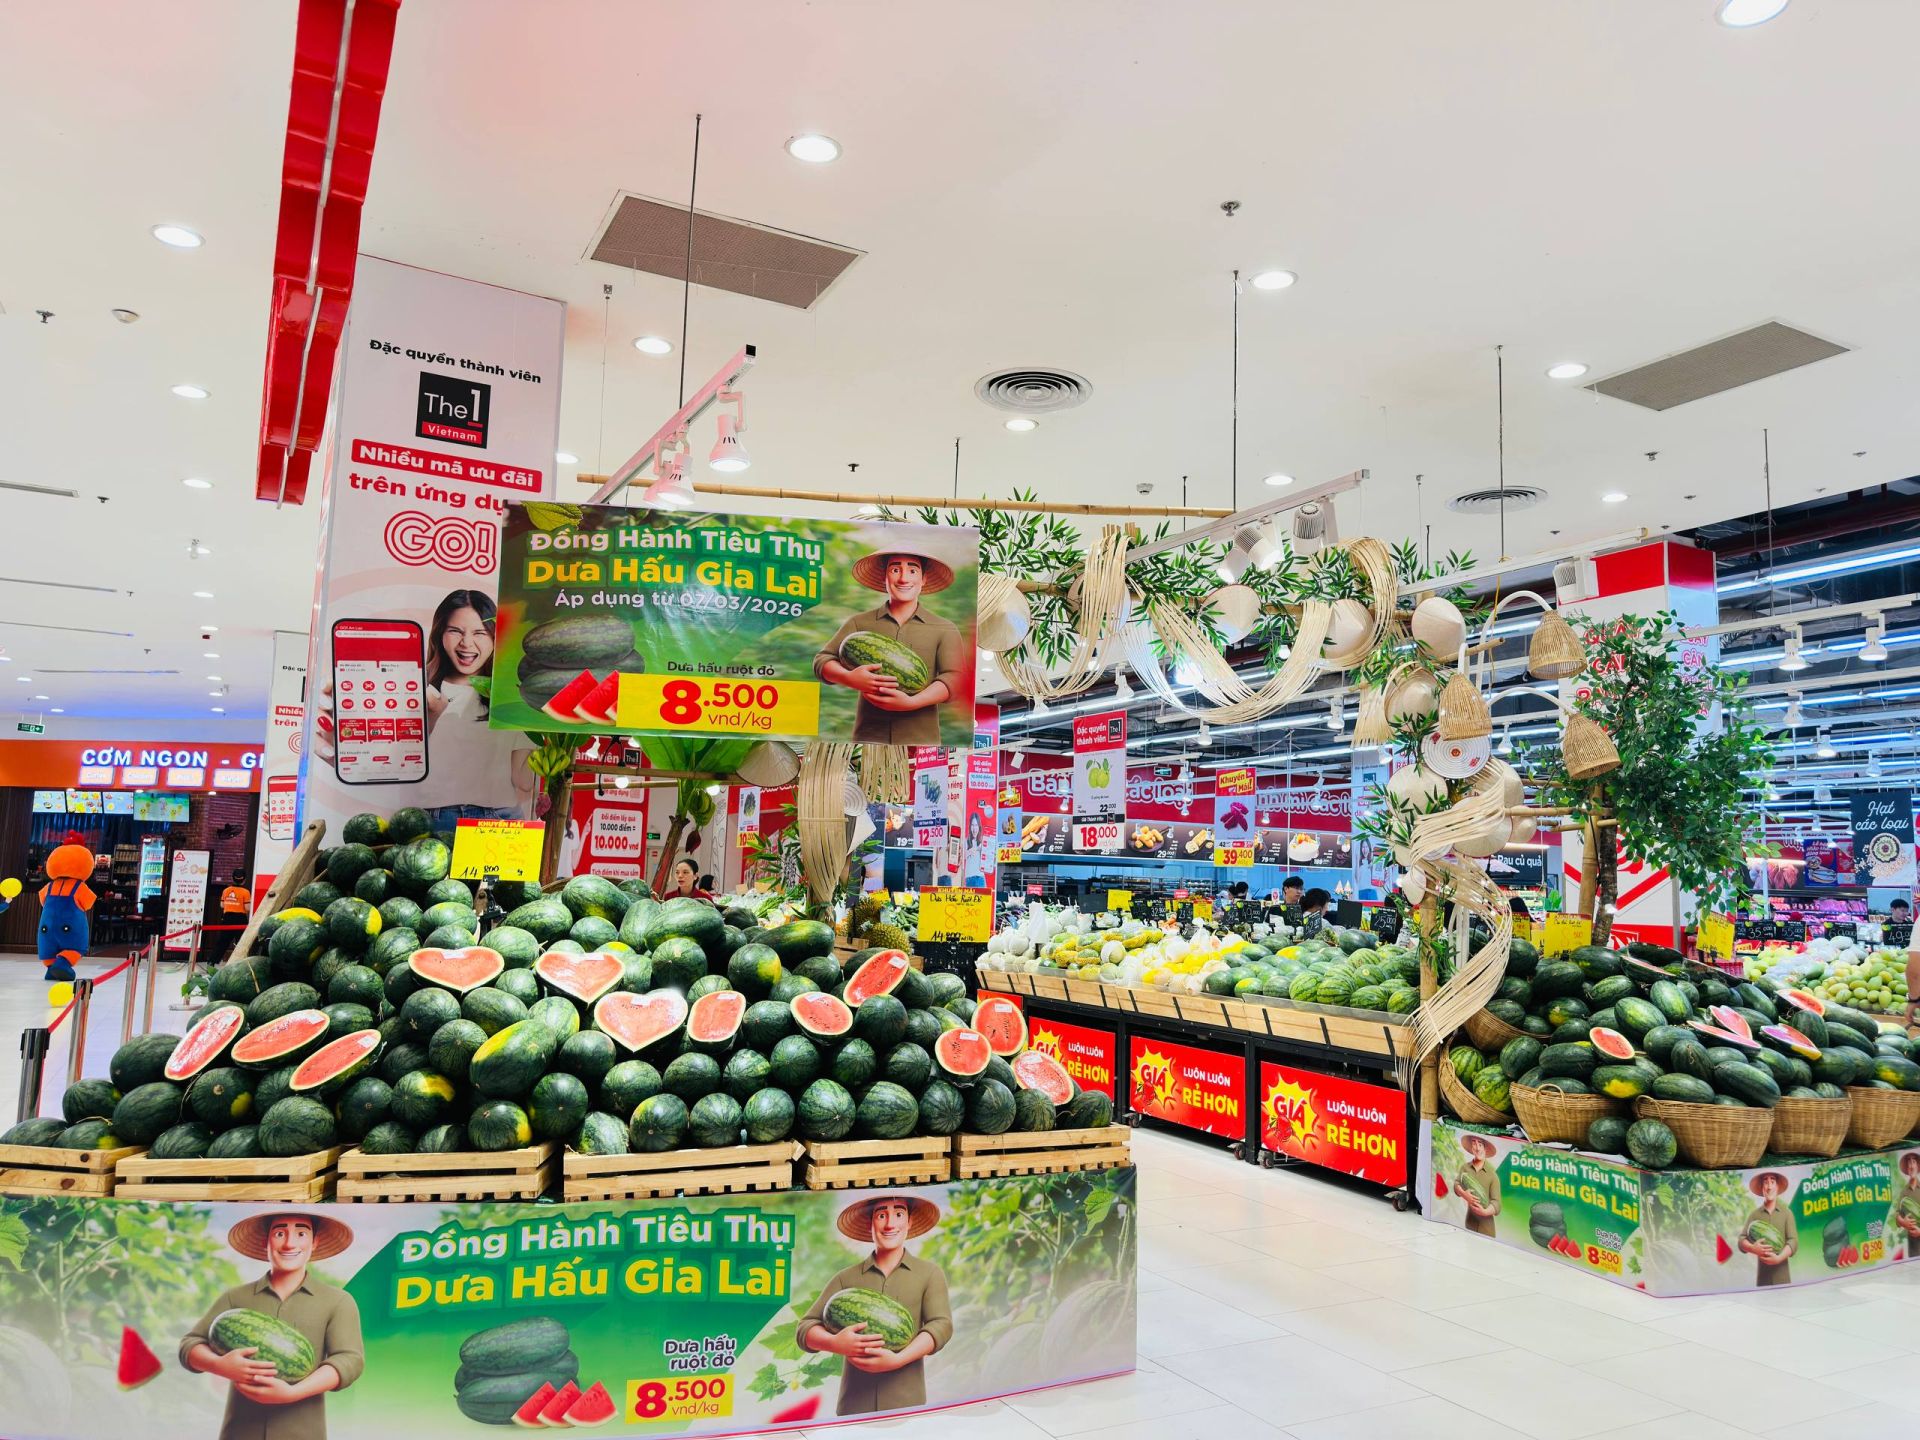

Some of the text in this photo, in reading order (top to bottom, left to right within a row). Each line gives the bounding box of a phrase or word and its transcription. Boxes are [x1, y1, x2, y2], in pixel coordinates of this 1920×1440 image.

[369, 339, 542, 384] Đặc quyền thành viên
[428, 424, 477, 442] Vietnam
[359, 445, 533, 487] Nhiều mã ưu đãi
[349, 472, 406, 497] trên
[415, 482, 467, 508] ứng
[530, 527, 821, 565] Đồng Hành Tiêu Thụ
[527, 553, 818, 599] Dưa Hấu Gia Lai
[554, 591, 585, 609] Áp
[591, 589, 645, 611] dụng
[651, 590, 677, 606] từ
[667, 660, 775, 677] Dưa hấu ruột đỏ
[659, 679, 779, 726] 8.500
[708, 711, 773, 731] vnd/kg
[81, 746, 131, 766] CƠM
[140, 750, 208, 767] NGON
[1867, 801, 1896, 817] Hạt
[600, 823, 618, 831] 10.000
[1855, 816, 1909, 831] các loại
[594, 834, 628, 850] 10.000
[918, 828, 944, 846] 12.500
[1080, 826, 1118, 848] 18.000
[1223, 849, 1253, 865] 39.400
[1515, 854, 1526, 866] củ
[1068, 1042, 1085, 1055] LUÔN
[1086, 1045, 1104, 1057] LUÔN
[1067, 1058, 1110, 1085] RẺ HƠN
[1140, 1060, 1231, 1088] GIÁ LUÔN LUÔN
[1182, 1084, 1239, 1118] RẺ HƠN
[1326, 1099, 1355, 1117] LUÔN
[1357, 1104, 1387, 1125] LUÔN
[1326, 1116, 1398, 1160] RẺ HƠN
[1510, 1153, 1639, 1199] Đồng Hành Tiêu Thụ
[1802, 1161, 1891, 1194] Đồng Hành Tiêu Thụ
[1510, 1171, 1639, 1223] Dưa Hấu Gia Lai
[1803, 1184, 1892, 1217] Dưa Hấu Gia Lai
[402, 1214, 791, 1263] Đồng Hành Tiêu Thụ
[1587, 1246, 1619, 1266] 8.500
[396, 1255, 786, 1309] Dưa Hấu Gia Lai
[665, 1335, 736, 1356] Dưa hấu
[670, 1351, 736, 1372] ruột đỏ
[634, 1378, 726, 1419] 8.500
[671, 1400, 720, 1417] vnd/kg
